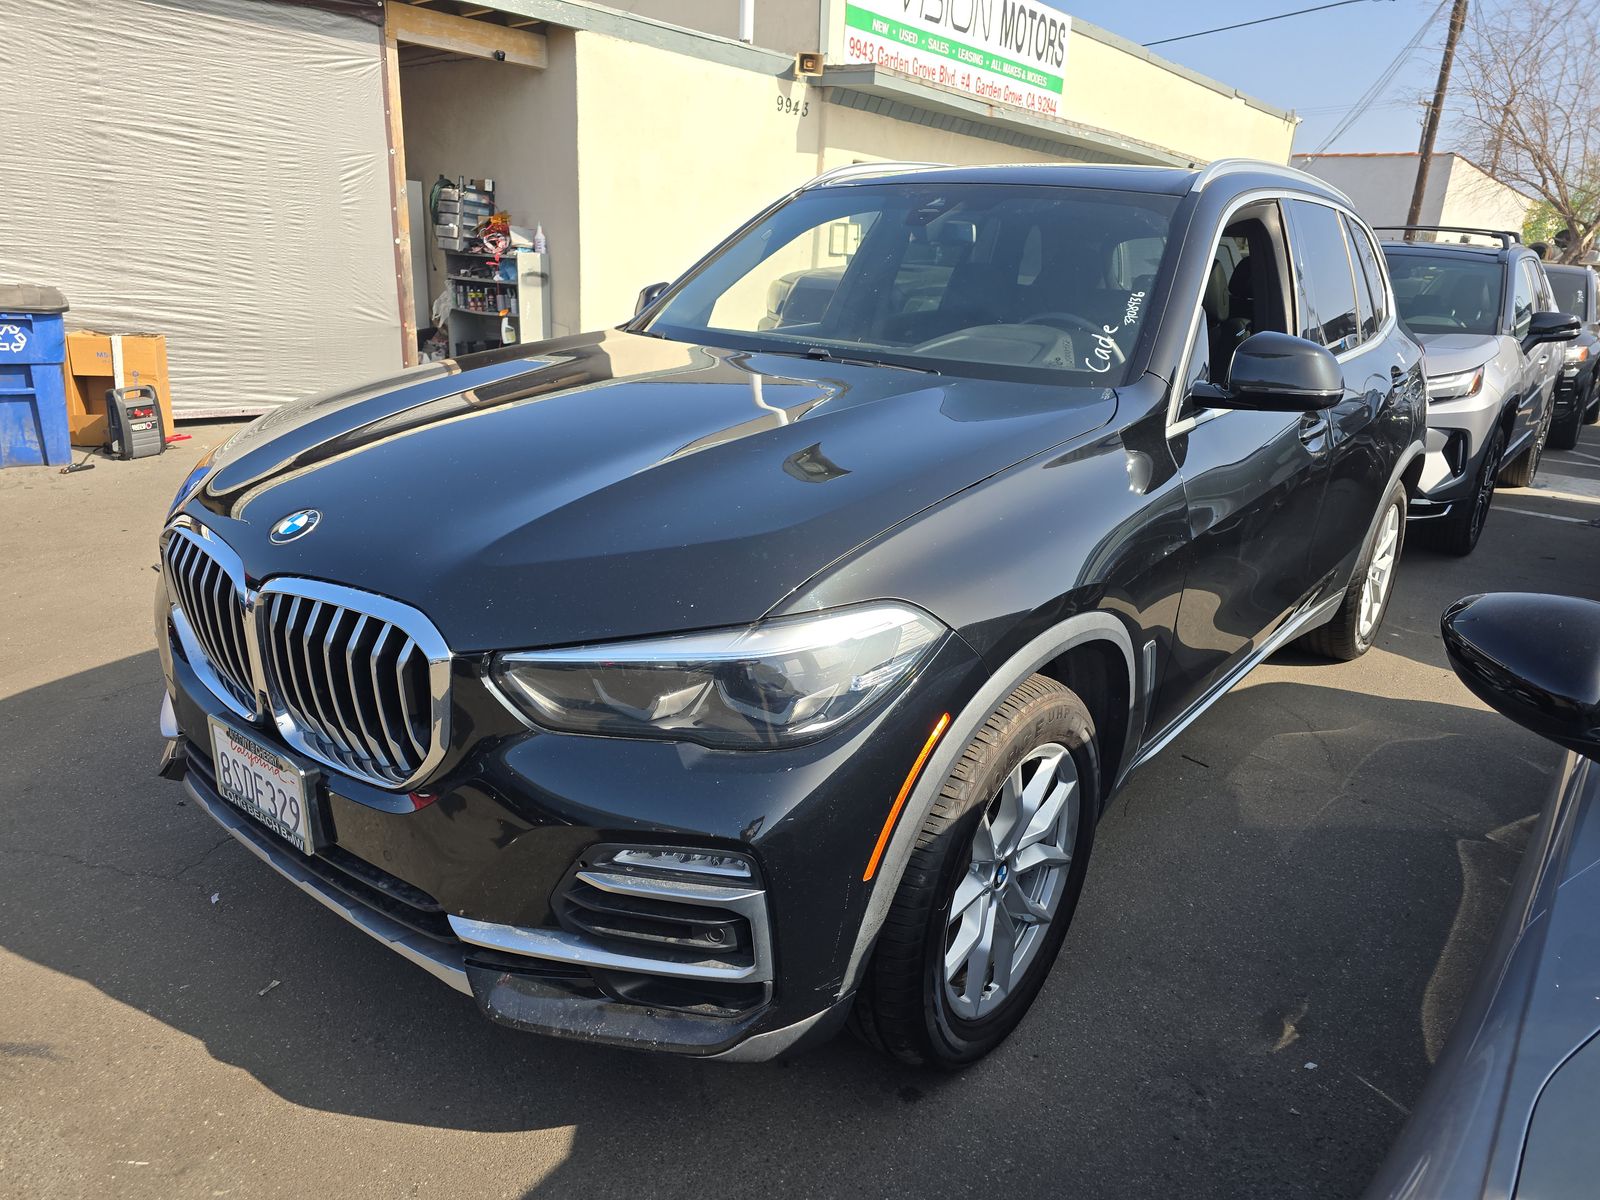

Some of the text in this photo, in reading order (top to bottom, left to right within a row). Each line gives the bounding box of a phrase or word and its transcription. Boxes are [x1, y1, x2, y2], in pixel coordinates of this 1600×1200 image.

[871, 18, 890, 35] NEW
[899, 29, 918, 44] USED
[927, 38, 950, 54] SALES
[957, 47, 984, 66] LEASING
[990, 59, 1002, 71] ALL
[1003, 62, 1022, 78] MAKES
[1026, 71, 1048, 87] MODELS
[902, 0, 1066, 68] SION MOTORS
[777, 95, 809, 117] 9943
[849, 37, 874, 62] 9943
[877, 46, 909, 71] Garden
[912, 57, 936, 80] Grove
[939, 65, 958, 86] Blvd.
[975, 76, 1002, 99] Garden
[1026, 92, 1035, 109] CA
[1085, 324, 1119, 373] Cade
[220, 751, 300, 833] 8SDF329
[221, 786, 247, 809] LONG
[247, 806, 280, 833] BEACH
